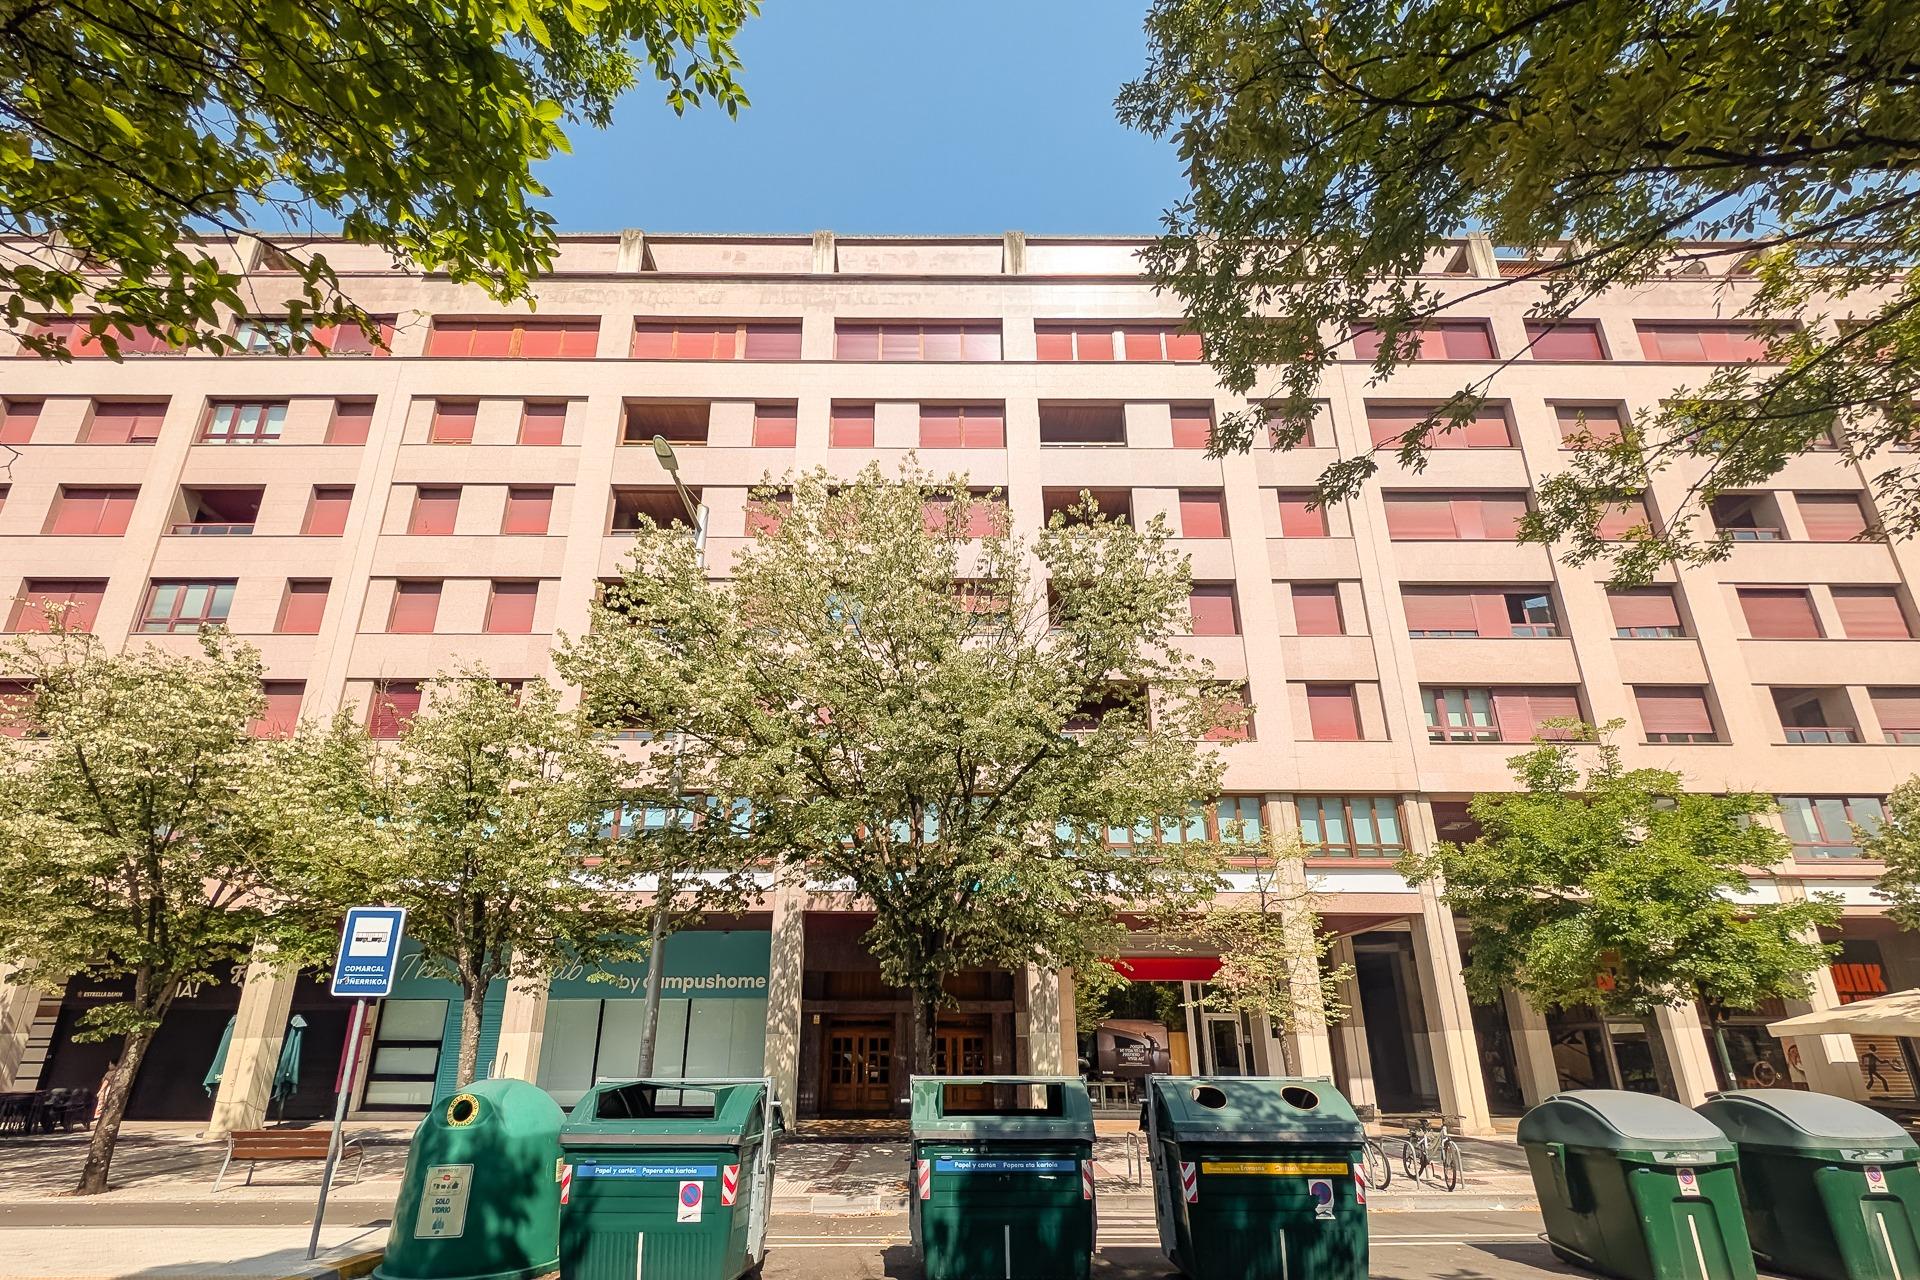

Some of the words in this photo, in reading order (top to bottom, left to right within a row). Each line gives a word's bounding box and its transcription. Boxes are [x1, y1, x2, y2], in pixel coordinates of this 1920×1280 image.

[1830, 963, 1888, 993] WOK
[619, 974, 640, 993] by
[954, 1161, 972, 1169] Papel
[977, 1161, 997, 1169] cartón
[1003, 1161, 1025, 1169] Papera
[594, 1166, 612, 1175] Papel
[642, 1167, 663, 1176] Papera
[435, 1198, 450, 1206] SOLO
[431, 1206, 451, 1214] VIDRIO
